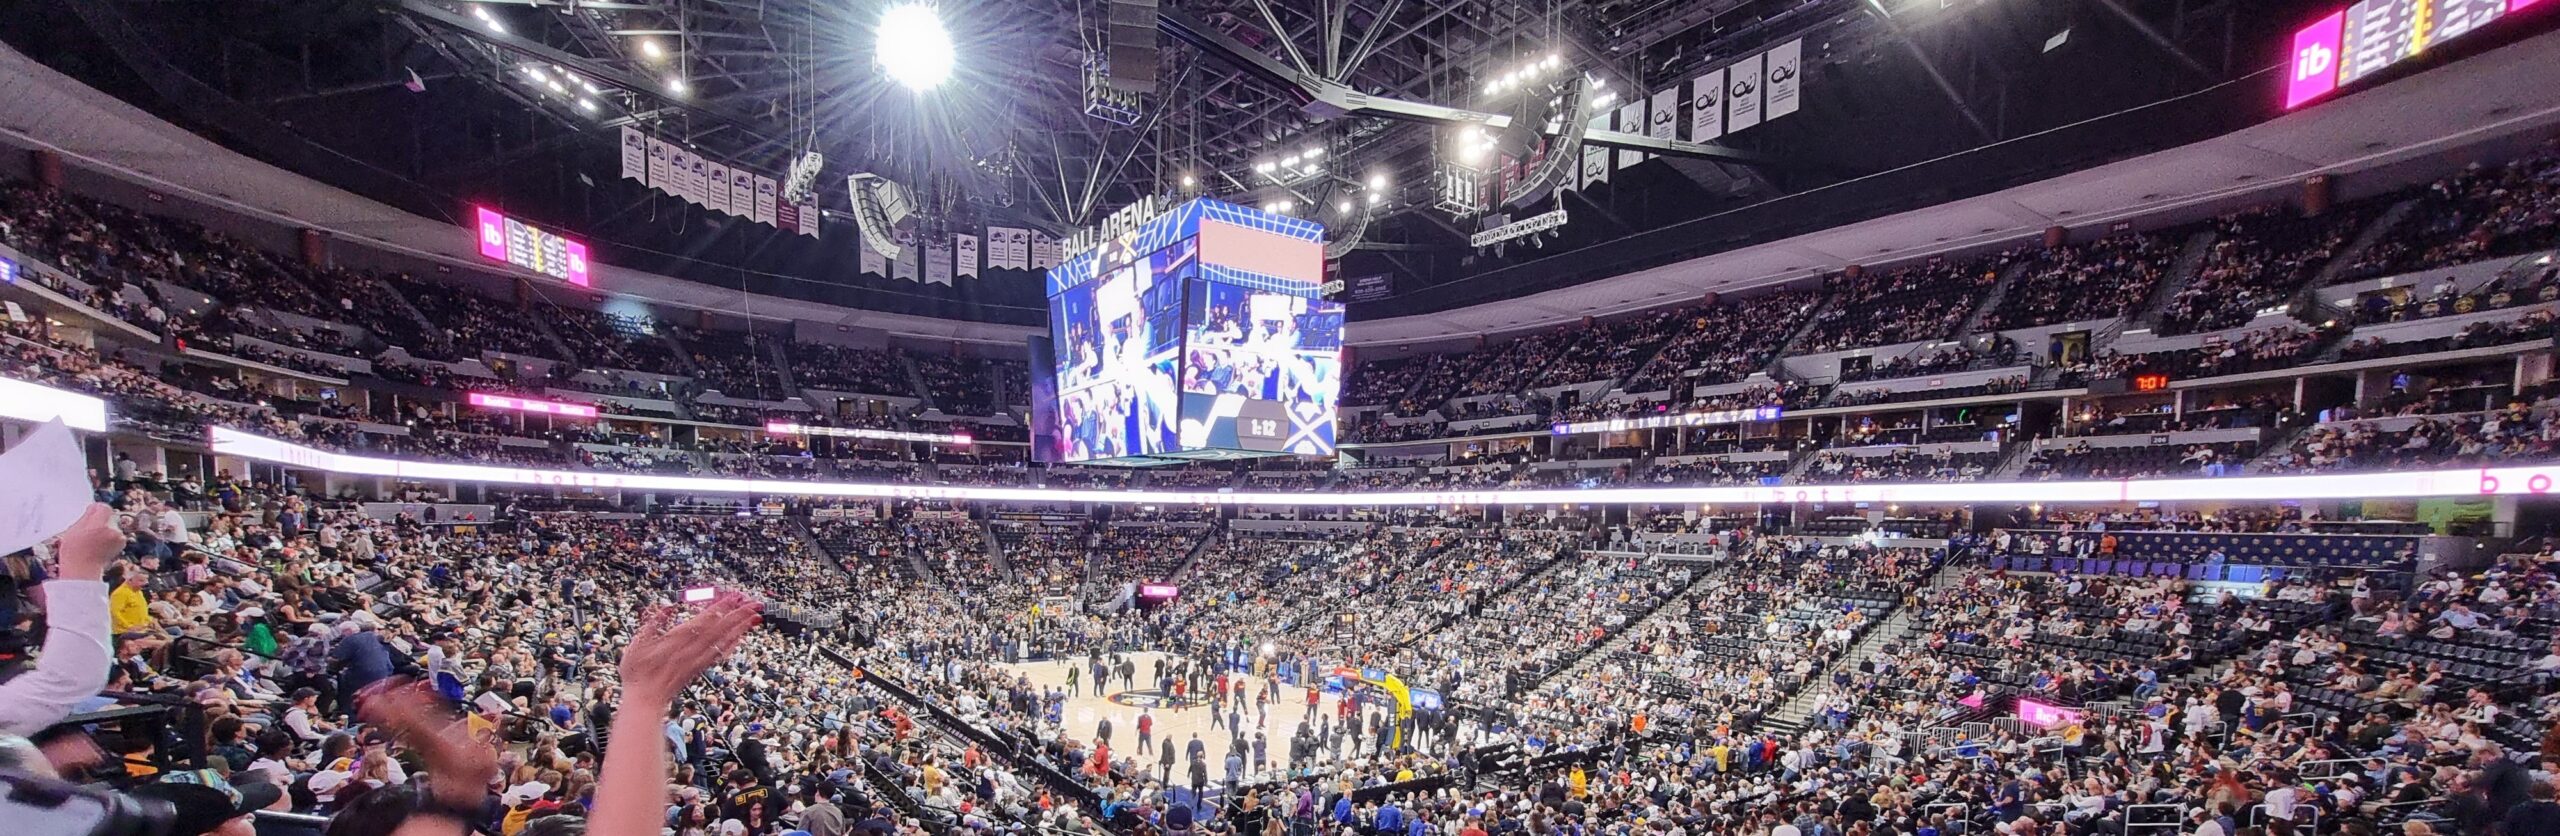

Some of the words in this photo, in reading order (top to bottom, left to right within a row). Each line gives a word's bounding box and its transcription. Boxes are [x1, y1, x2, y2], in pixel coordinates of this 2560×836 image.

[2297, 42, 2332, 81] ib
[483, 222, 502, 246] ib
[1062, 225, 1097, 262] BALL
[1100, 194, 1155, 244] ARENA
[570, 253, 585, 274] ib
[2136, 376, 2167, 389] 7:01
[1251, 418, 1277, 437] 1:12
